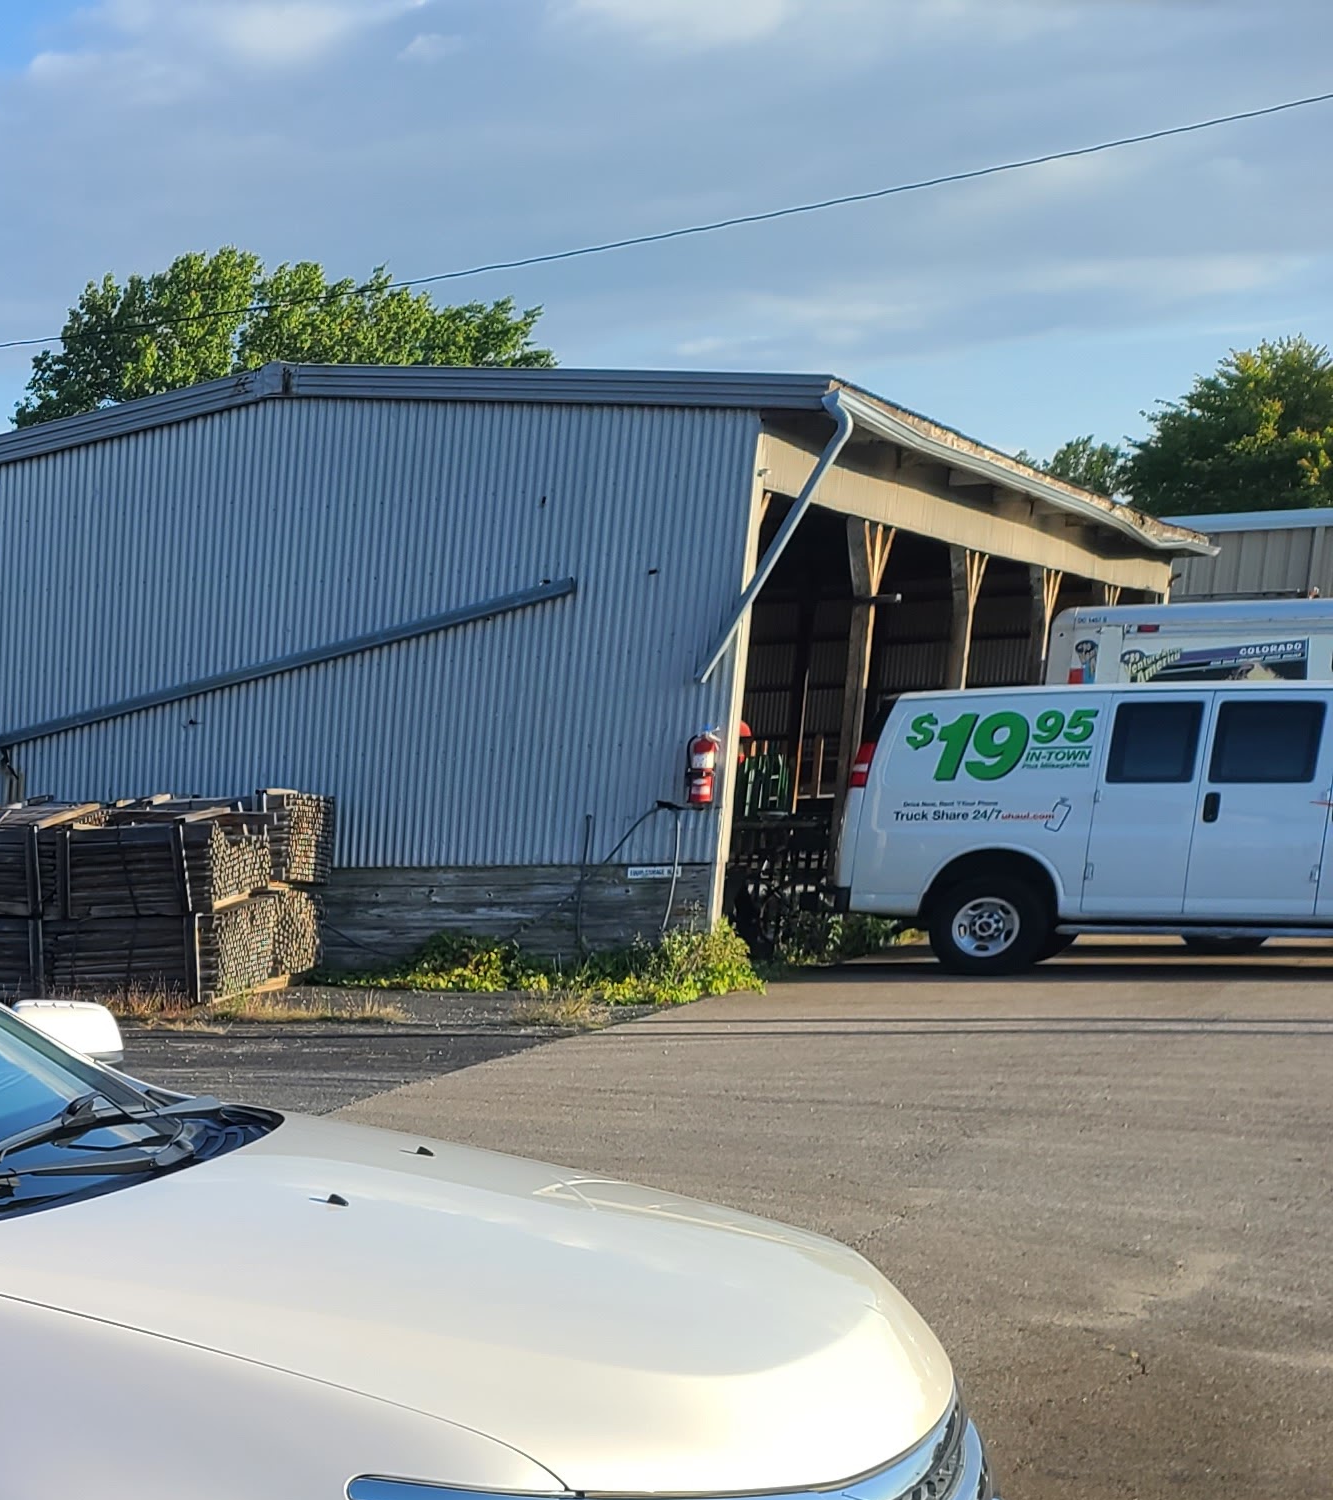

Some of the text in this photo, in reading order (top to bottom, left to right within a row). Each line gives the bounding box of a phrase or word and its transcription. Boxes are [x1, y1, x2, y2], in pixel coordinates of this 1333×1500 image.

[1239, 642, 1302, 656] COLORADO
[1136, 652, 1181, 683] America
[1024, 750, 1091, 762] IN-TOWN
[894, 808, 1055, 821] Truck Share 24/7 uhaul.com
